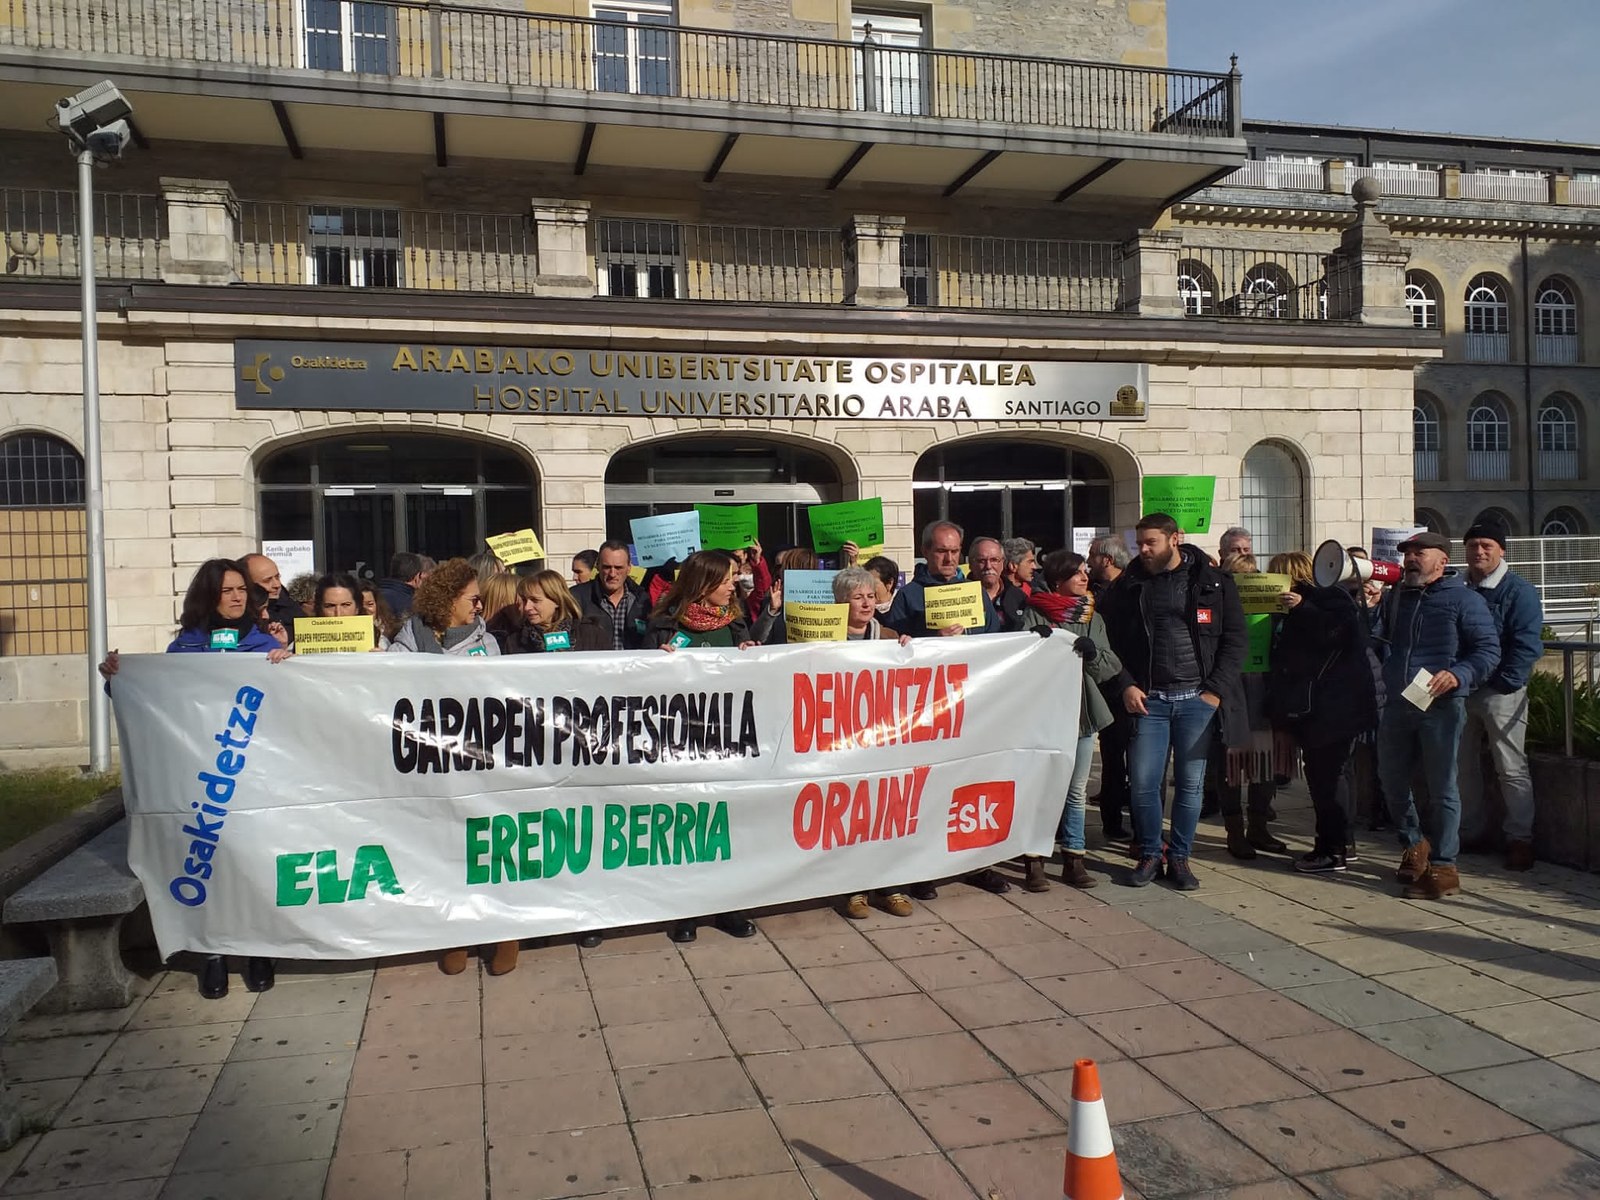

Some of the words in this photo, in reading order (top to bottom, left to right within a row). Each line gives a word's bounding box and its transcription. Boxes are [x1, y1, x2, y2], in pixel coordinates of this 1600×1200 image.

[291, 356, 368, 369] Osakidetza
[392, 346, 576, 375] ARABAKO
[589, 353, 853, 383] UNIBERTSITATE
[865, 361, 1037, 386] OSPITALEA
[474, 385, 629, 412] HOSPITAL
[640, 390, 865, 416] UNIVERSITARIO
[878, 395, 972, 418] ARABA
[1005, 401, 1101, 415] SANTIAGO
[392, 695, 545, 774] GARAPEN
[552, 690, 760, 766] PROFESIONALA
[793, 663, 969, 754] DENONTZAT
[169, 684, 265, 907] Osakidetza
[466, 805, 594, 886] EREDU
[602, 801, 731, 870] BERRIA
[793, 765, 931, 851] ORAIN!
[276, 845, 405, 908] ELA
